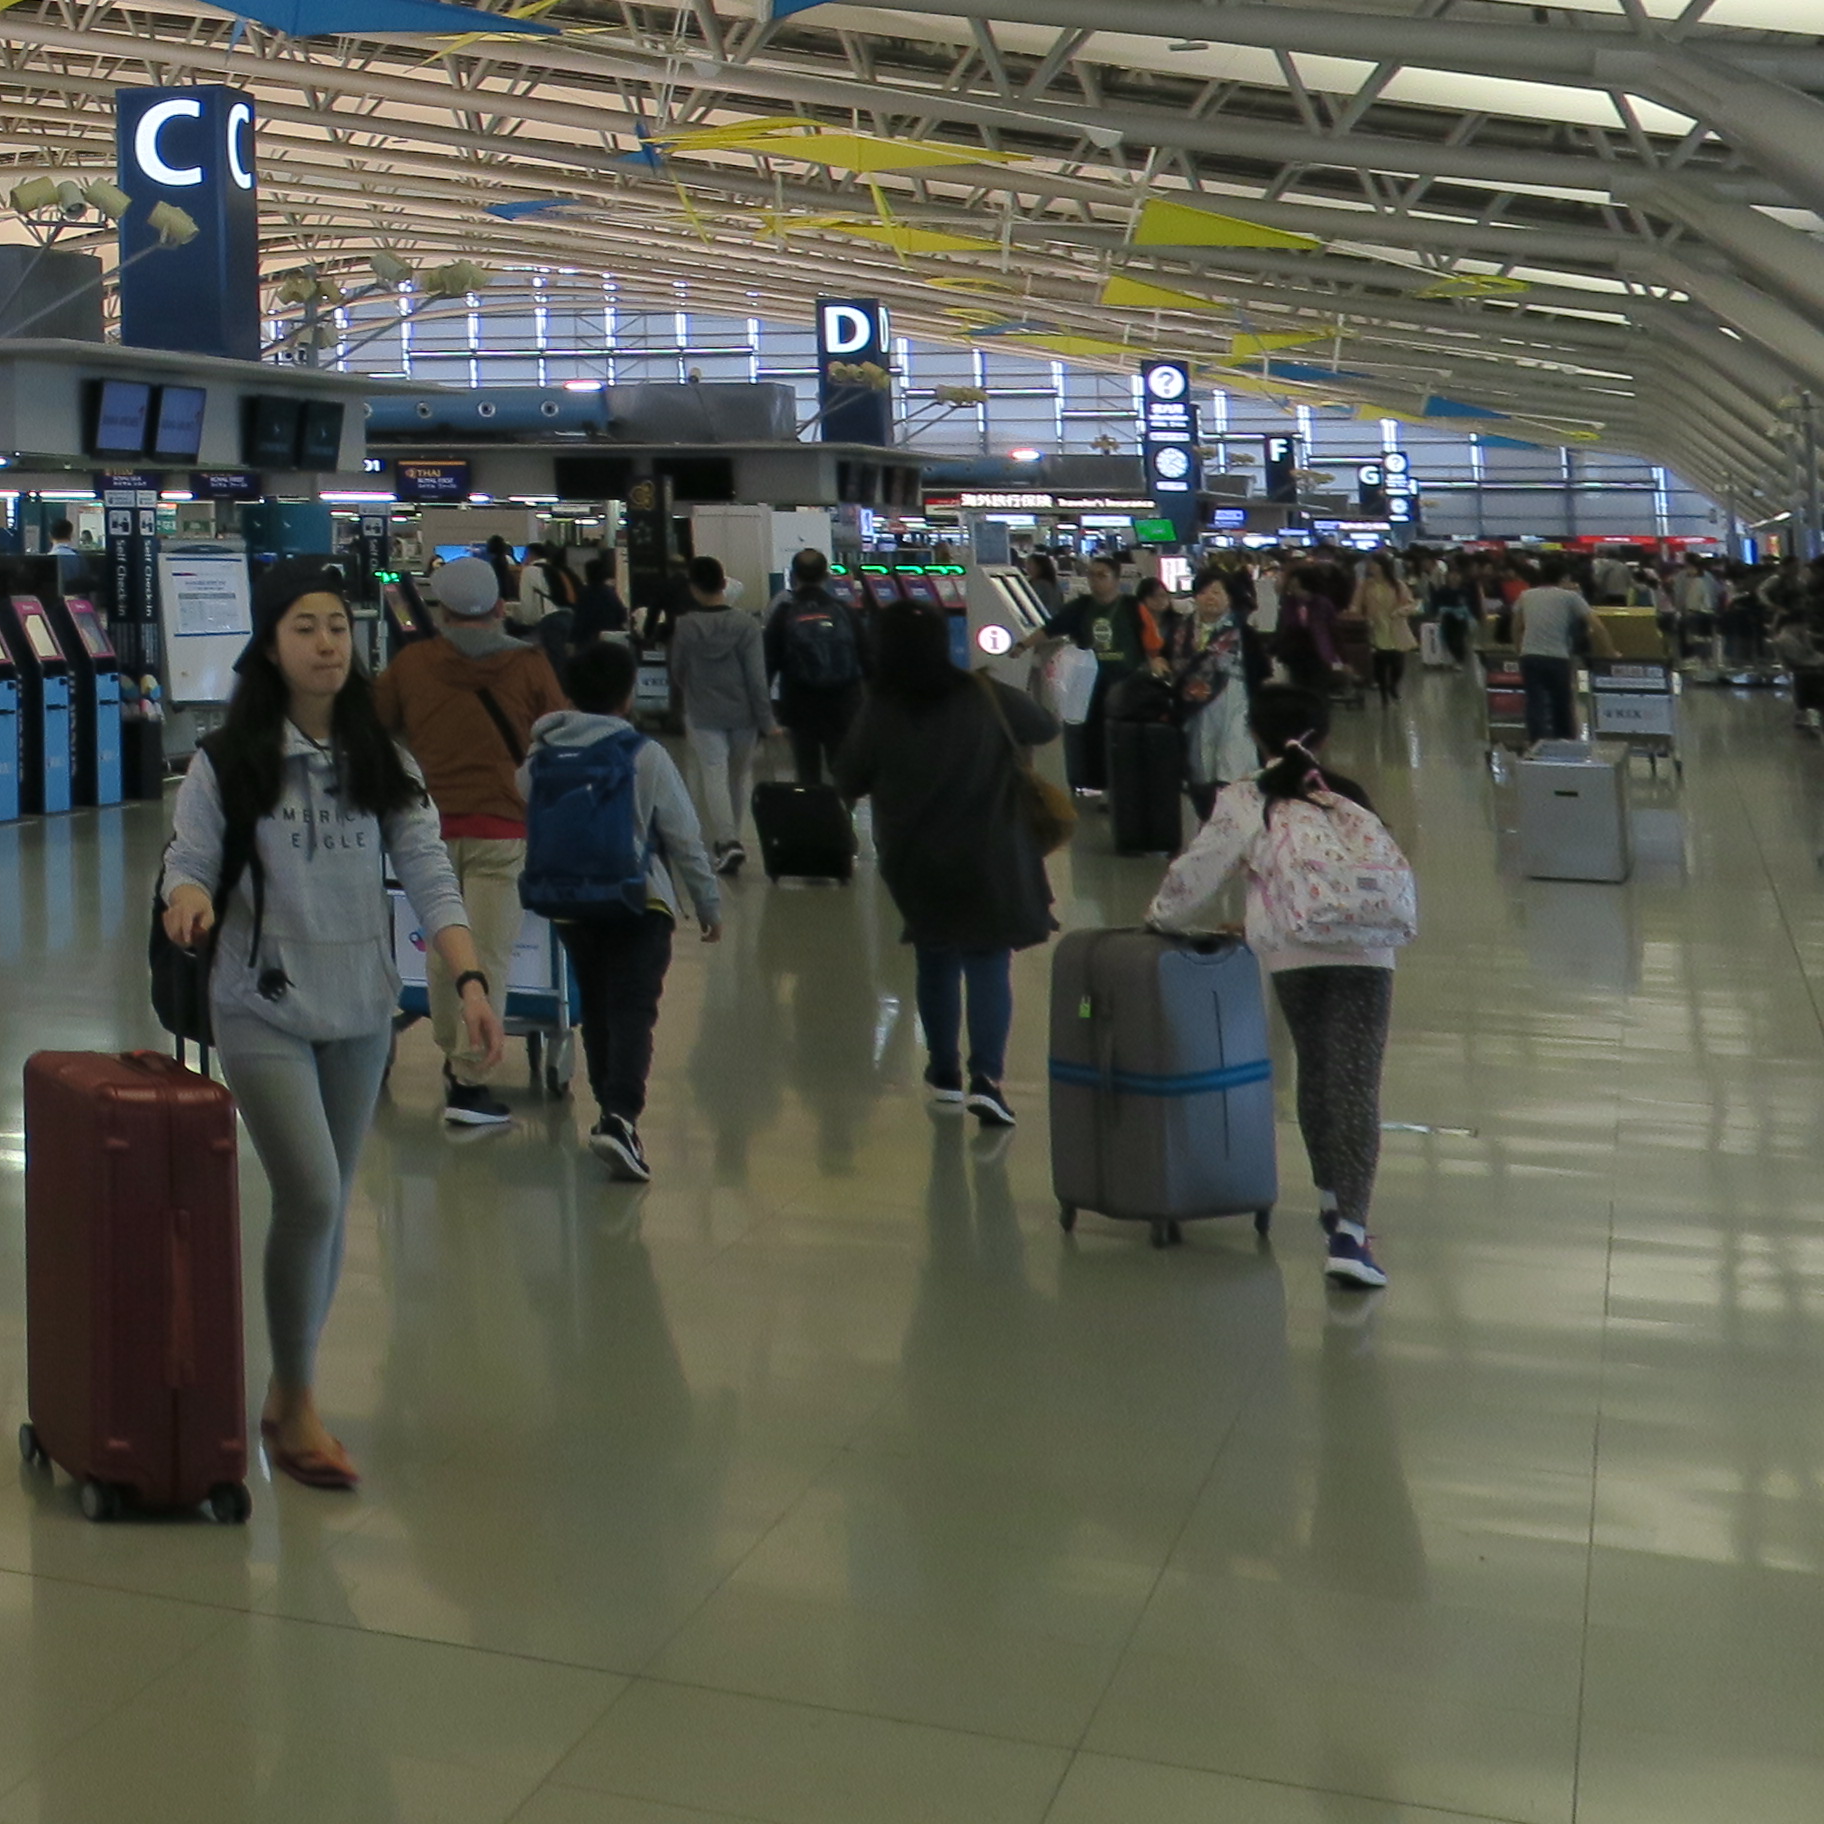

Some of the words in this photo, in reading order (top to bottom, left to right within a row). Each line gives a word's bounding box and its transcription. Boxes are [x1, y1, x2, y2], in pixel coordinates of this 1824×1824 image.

[134, 97, 203, 186] C
[823, 306, 871, 354] D
[1269, 438, 1288, 462] F
[1359, 465, 1380, 485] G
[291, 832, 366, 850] EGLE
